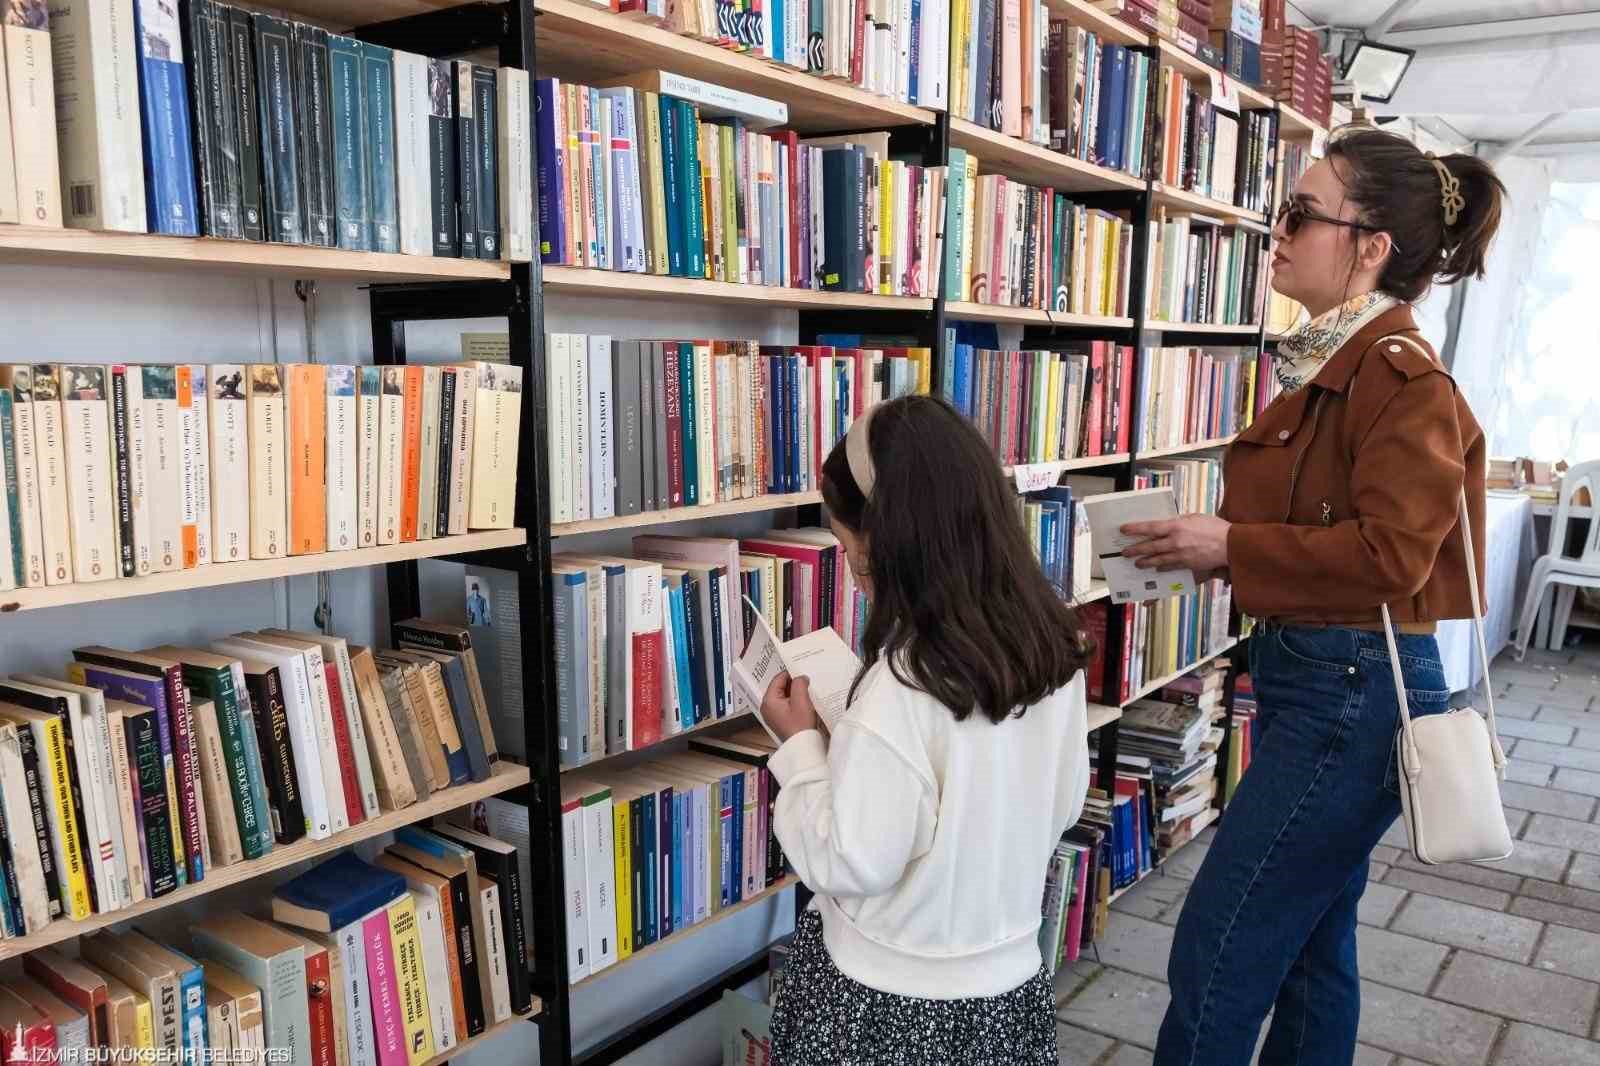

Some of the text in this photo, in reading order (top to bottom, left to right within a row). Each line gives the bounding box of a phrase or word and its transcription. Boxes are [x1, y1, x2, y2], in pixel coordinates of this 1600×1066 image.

[273, 45, 281, 73] CHARLES
[115, 376, 123, 412] NATHANIEL
[666, 351, 675, 418] HEZEYANI
[19, 408, 31, 457] TROLLOPE
[43, 405, 55, 447] CONRAD
[82, 407, 92, 455] TROLLOPE
[117, 412, 125, 453] HAWTHORNE
[156, 402, 164, 430] ELIOT
[227, 402, 235, 430] SCOTT
[265, 404, 273, 434] HARDY
[599, 391, 607, 457] HOMINTERN
[626, 406, 634, 451] LEVINAS
[173, 671, 187, 736] FIGHT CLUB
[270, 699, 282, 741] CHILD
[49, 725, 62, 761] THORNTON
[137, 742, 155, 790] FEIST
[237, 768, 251, 792] BOOK
[60, 800, 71, 818] TOWN
[181, 753, 200, 852] CHUCK PALAHNIUK
[63, 820, 73, 833] AND
[65, 834, 76, 854] OTHER
[69, 855, 79, 874] PLAYS
[399, 942, 409, 975] TÜRKÇE
[408, 937, 424, 1019] TÜRKÇE İTALYANCA
[162, 985, 176, 1031] PEST
[373, 932, 397, 1052] RUSÇA TEMEL SÖZLÜK
[404, 981, 415, 1024] İTALYANCA
